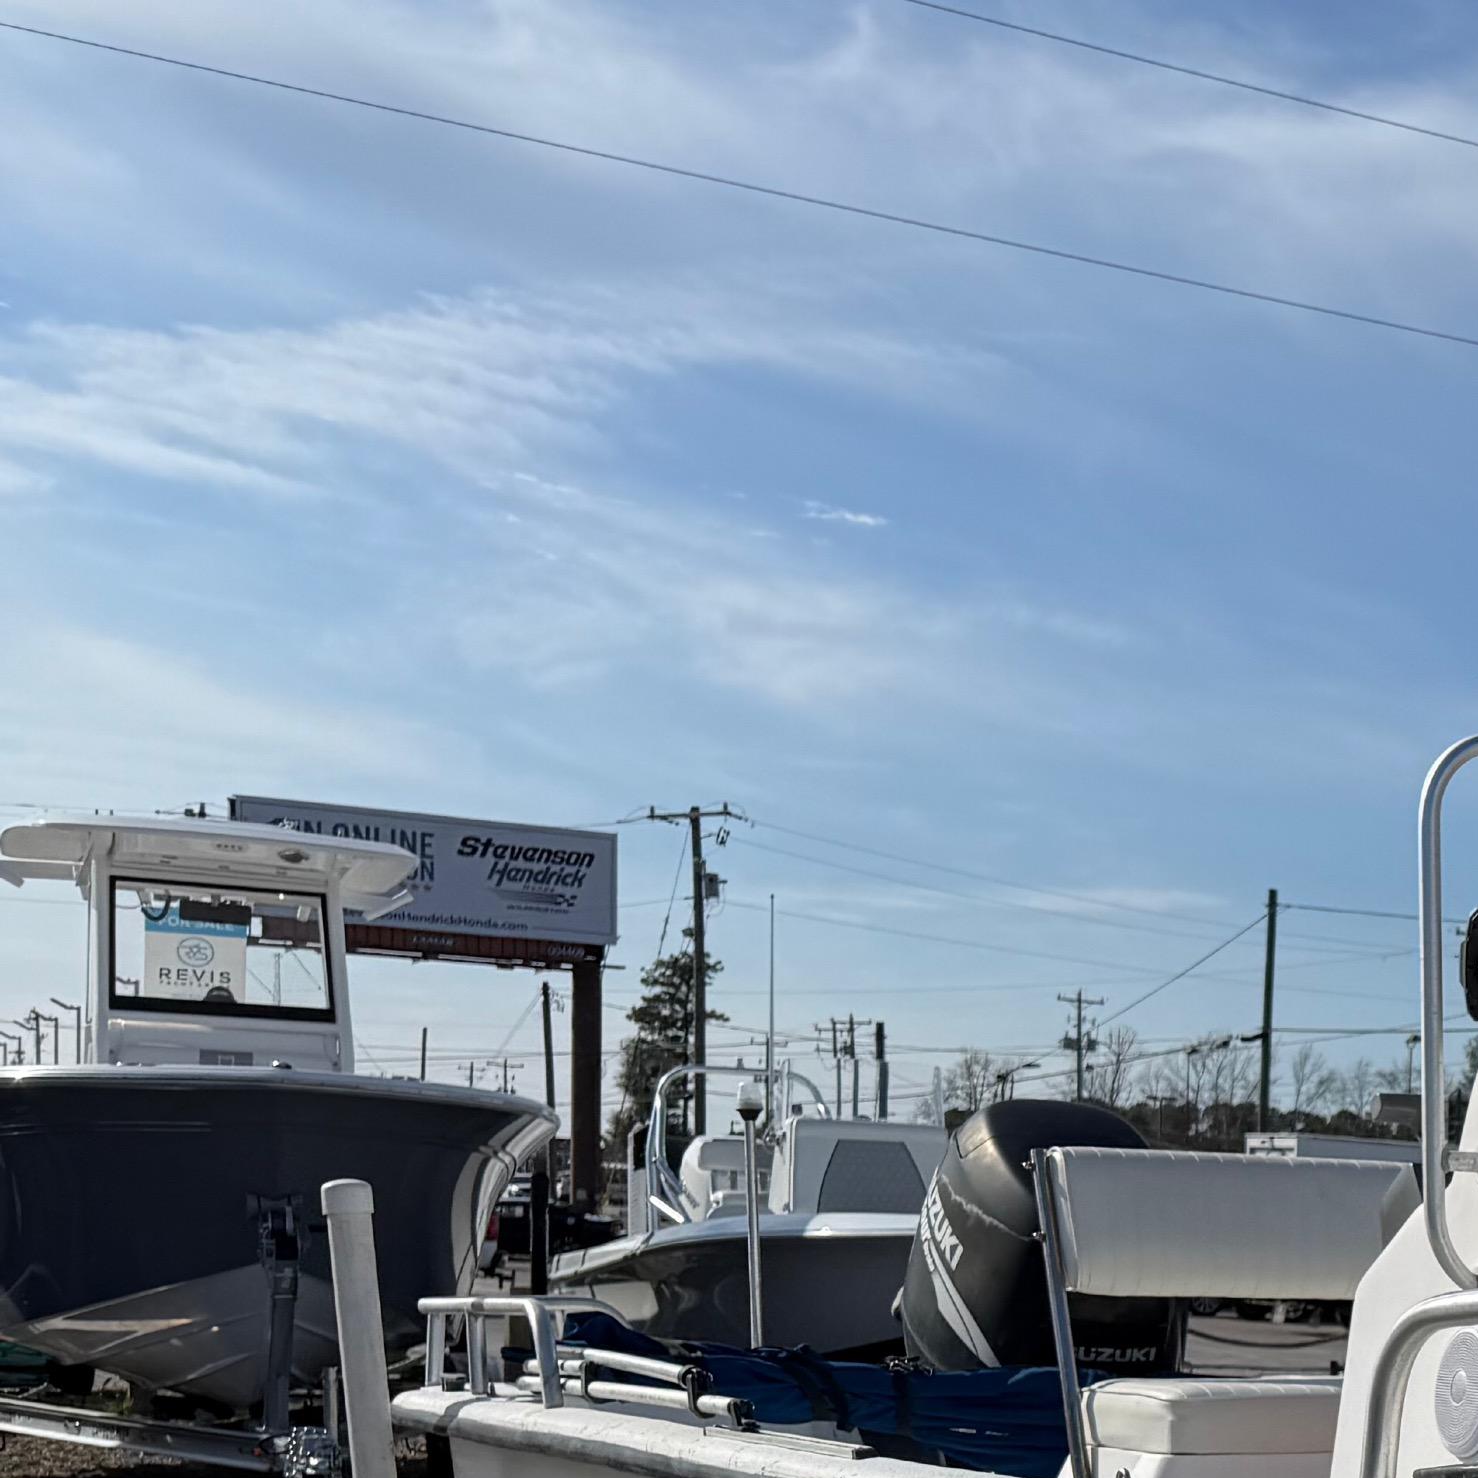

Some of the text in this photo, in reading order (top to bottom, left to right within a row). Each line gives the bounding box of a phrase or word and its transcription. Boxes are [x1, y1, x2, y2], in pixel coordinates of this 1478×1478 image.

[457, 835, 595, 869] Stevenson
[487, 861, 587, 889] Hendrick
[158, 967, 232, 985] REVIS
